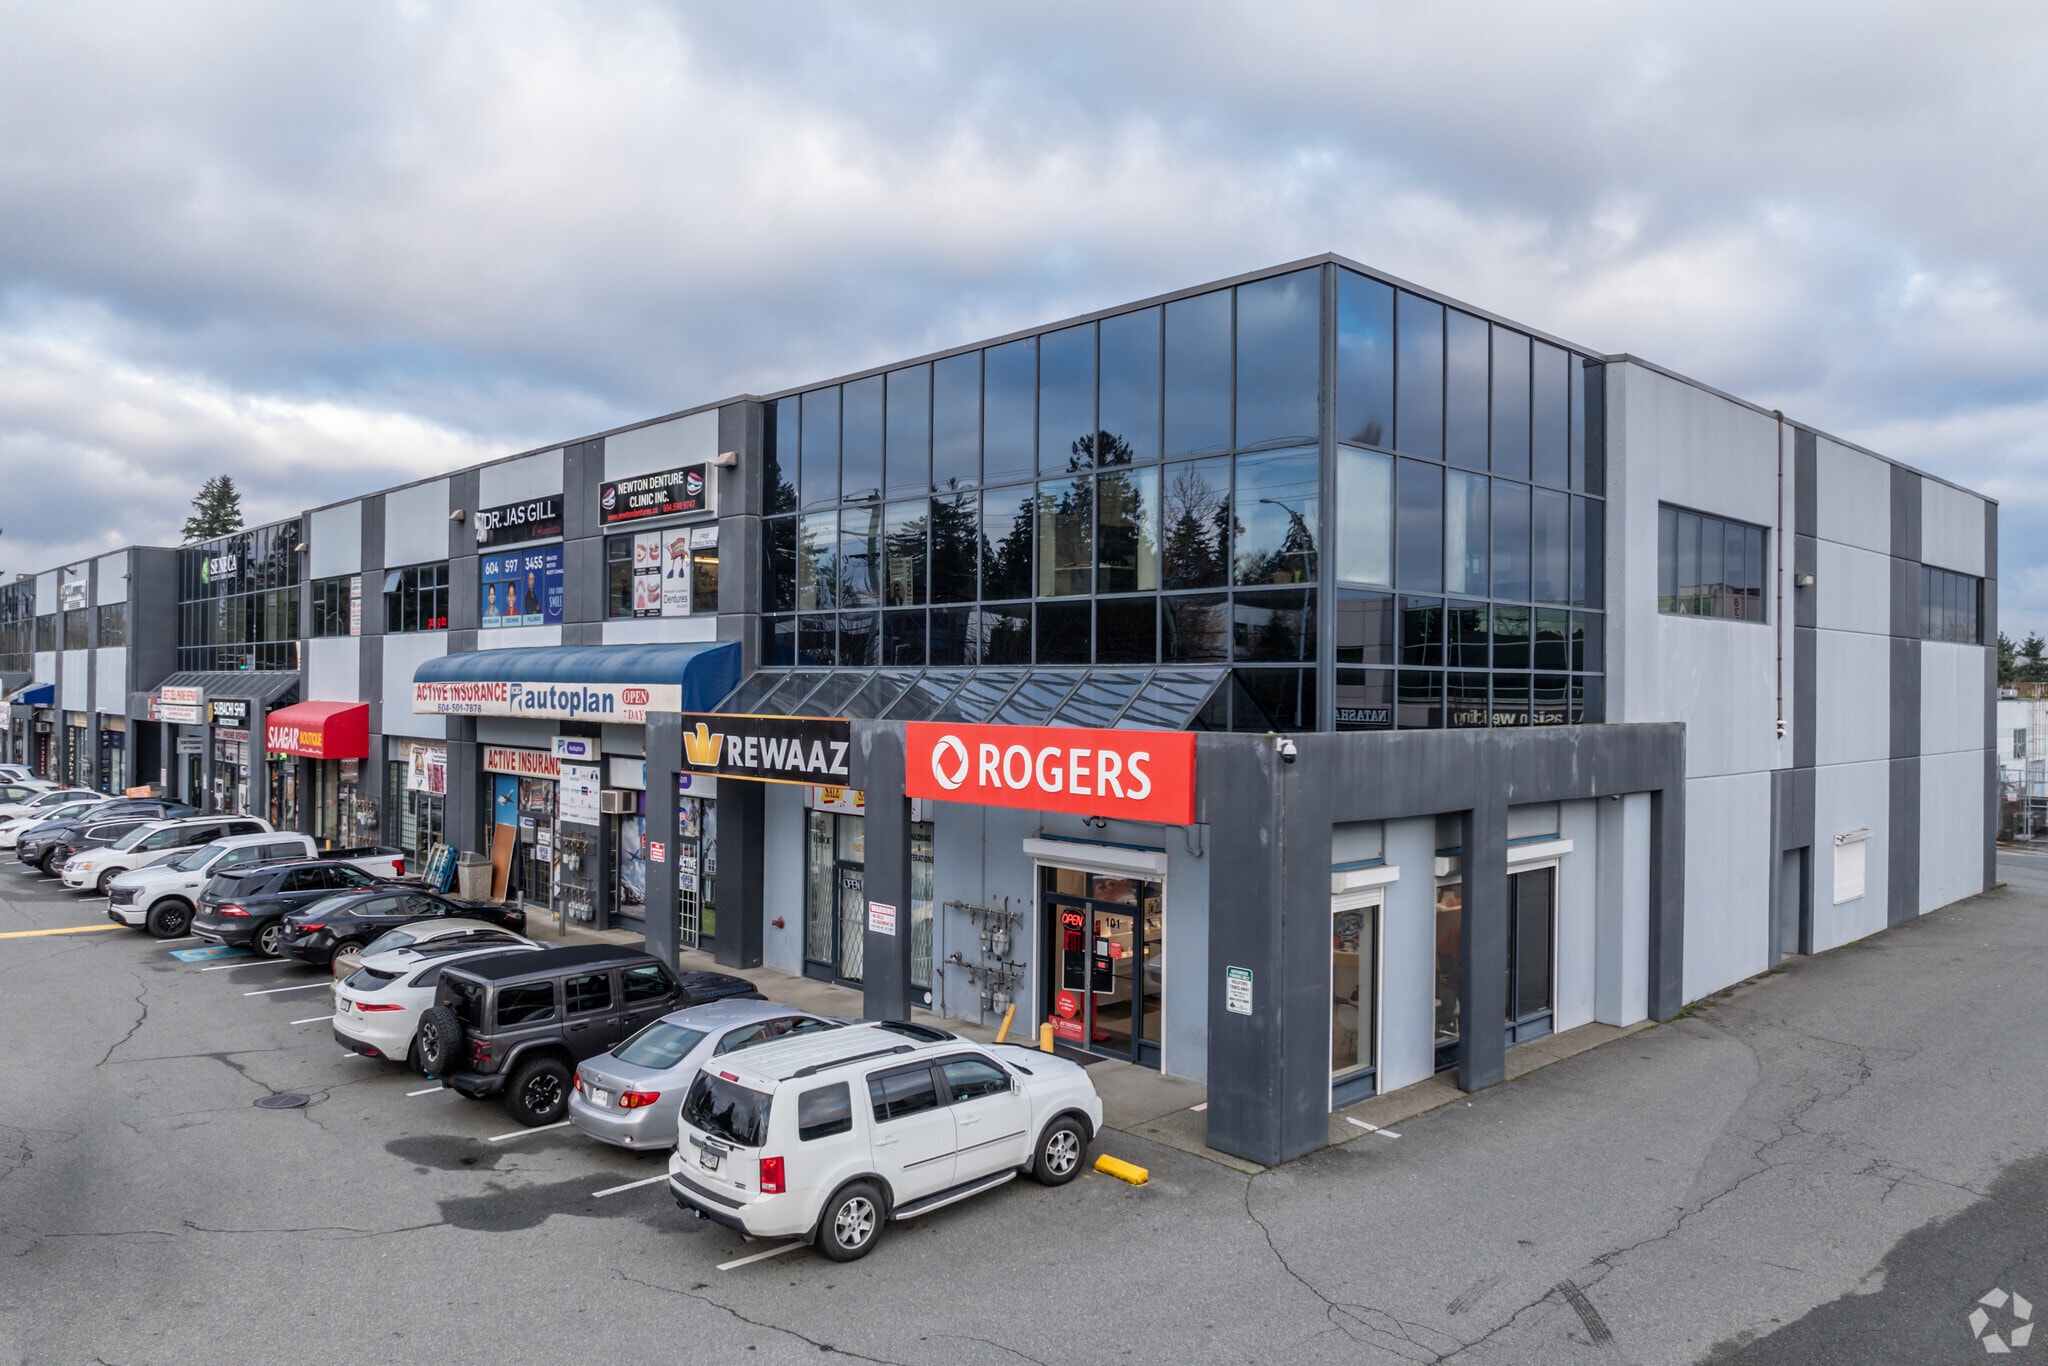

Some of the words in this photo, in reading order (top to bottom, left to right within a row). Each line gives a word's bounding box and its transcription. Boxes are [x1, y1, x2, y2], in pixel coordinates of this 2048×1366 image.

[618, 477, 649, 495] NEWTON
[649, 471, 684, 489] DENTURE
[629, 493, 654, 508] CLINIC
[654, 490, 669, 503] INC.
[484, 511, 502, 530] DR.
[503, 506, 525, 526] JAS
[527, 500, 556, 522] GILL
[210, 554, 237, 575] SENECA
[485, 561, 499, 575] 604
[505, 558, 518, 573] 597
[525, 555, 543, 571] 3455
[664, 595, 688, 604] Dentures
[417, 684, 448, 701] ACTIVE
[450, 682, 507, 702] INSURANCE
[623, 691, 647, 704] OPEN
[525, 685, 614, 717] autoplan
[268, 726, 299, 750] SAAGAR
[299, 731, 322, 747] BOUTIQUE
[488, 749, 517, 771] ACTIVE
[727, 736, 849, 775] REWAAZ
[979, 743, 1151, 800] ROGERS
[825, 787, 840, 799] SALE
[682, 874, 694, 885] OPEN
[844, 878, 861, 890] OPEN
[1061, 913, 1084, 927] OPEN
[1105, 918, 1120, 929] 101
[1060, 1021, 1081, 1030] ATTENTION
